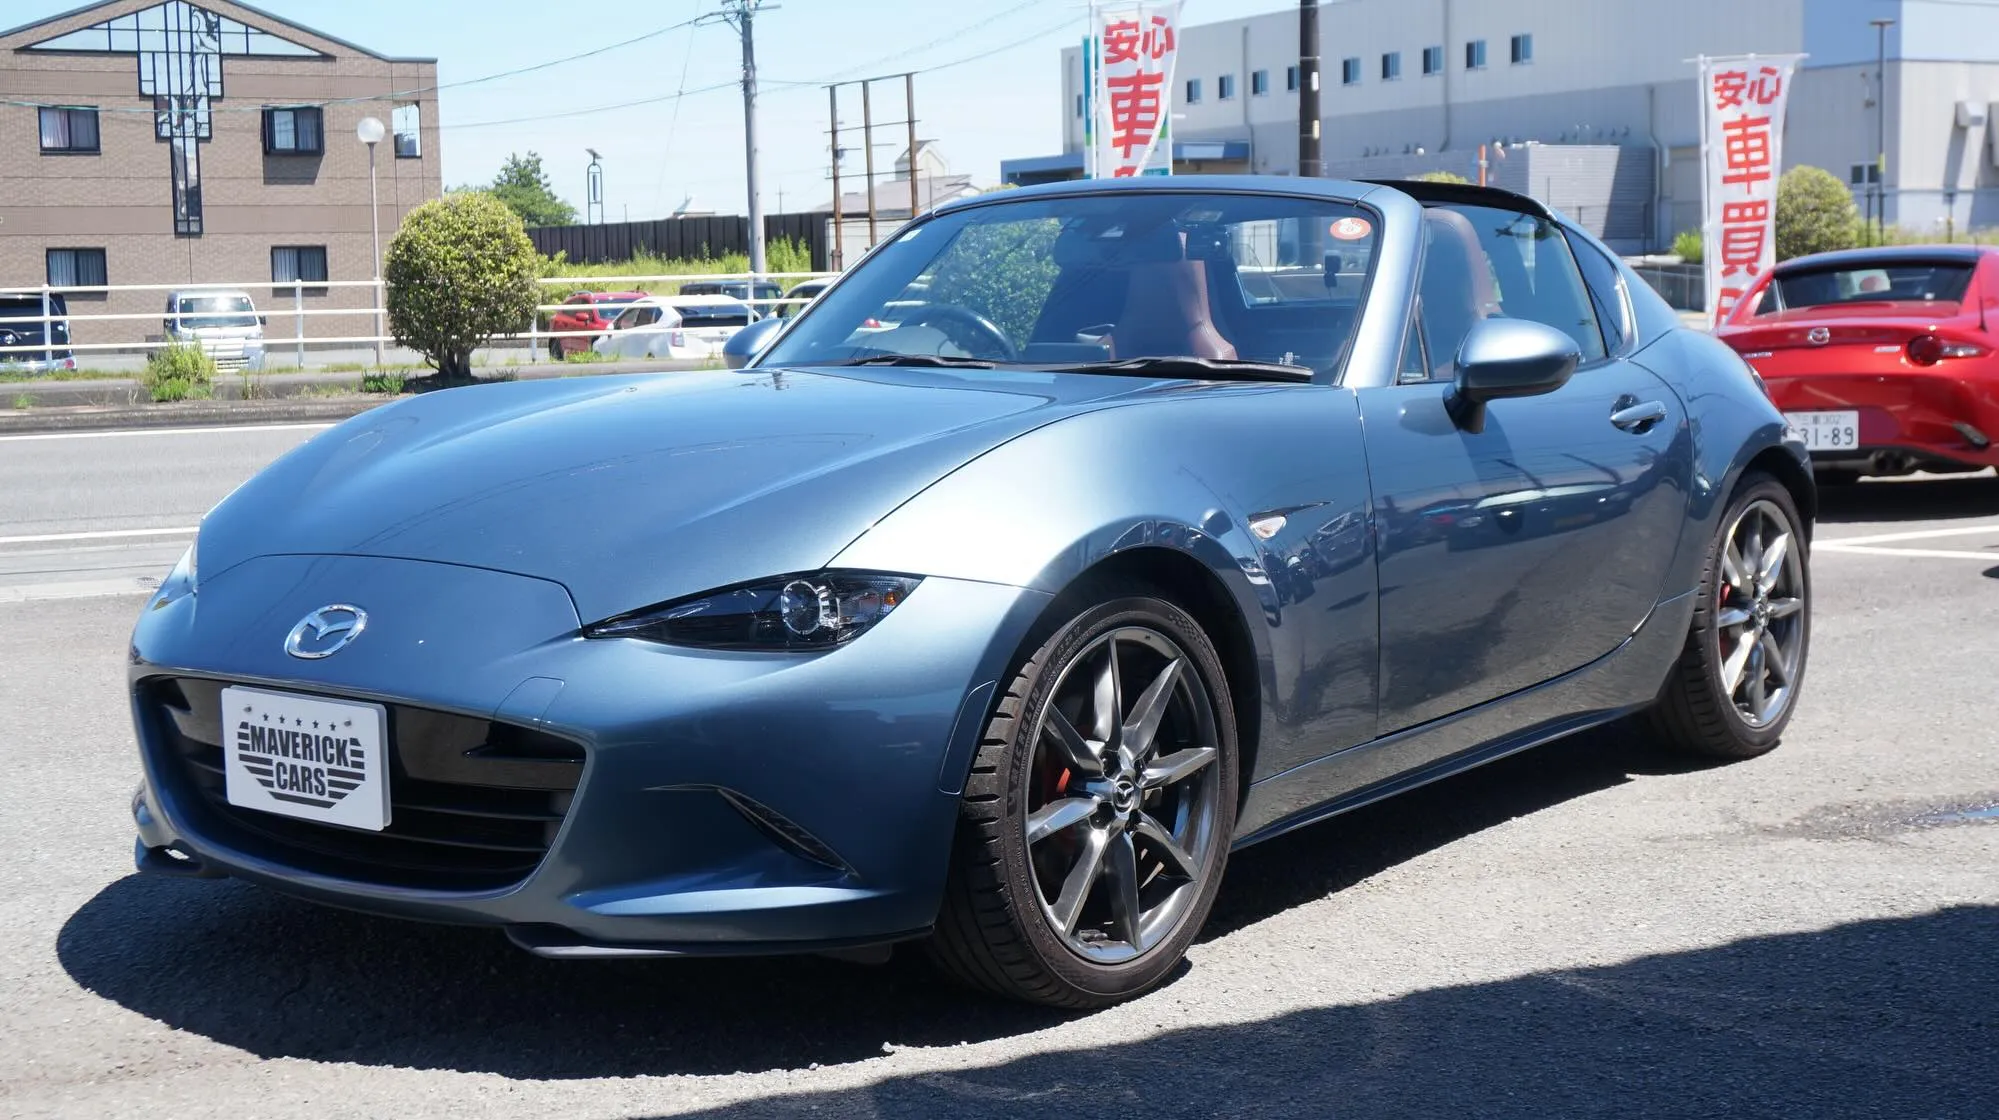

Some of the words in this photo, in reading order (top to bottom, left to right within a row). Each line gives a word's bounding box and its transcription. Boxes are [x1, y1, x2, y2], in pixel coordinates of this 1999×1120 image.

[1104, 16, 1175, 64] 安心
[1714, 67, 1781, 110] 安心
[250, 725, 349, 767] MAVERICK
[1010, 687, 1040, 785] MICHELIN
[276, 762, 326, 797] CARS
